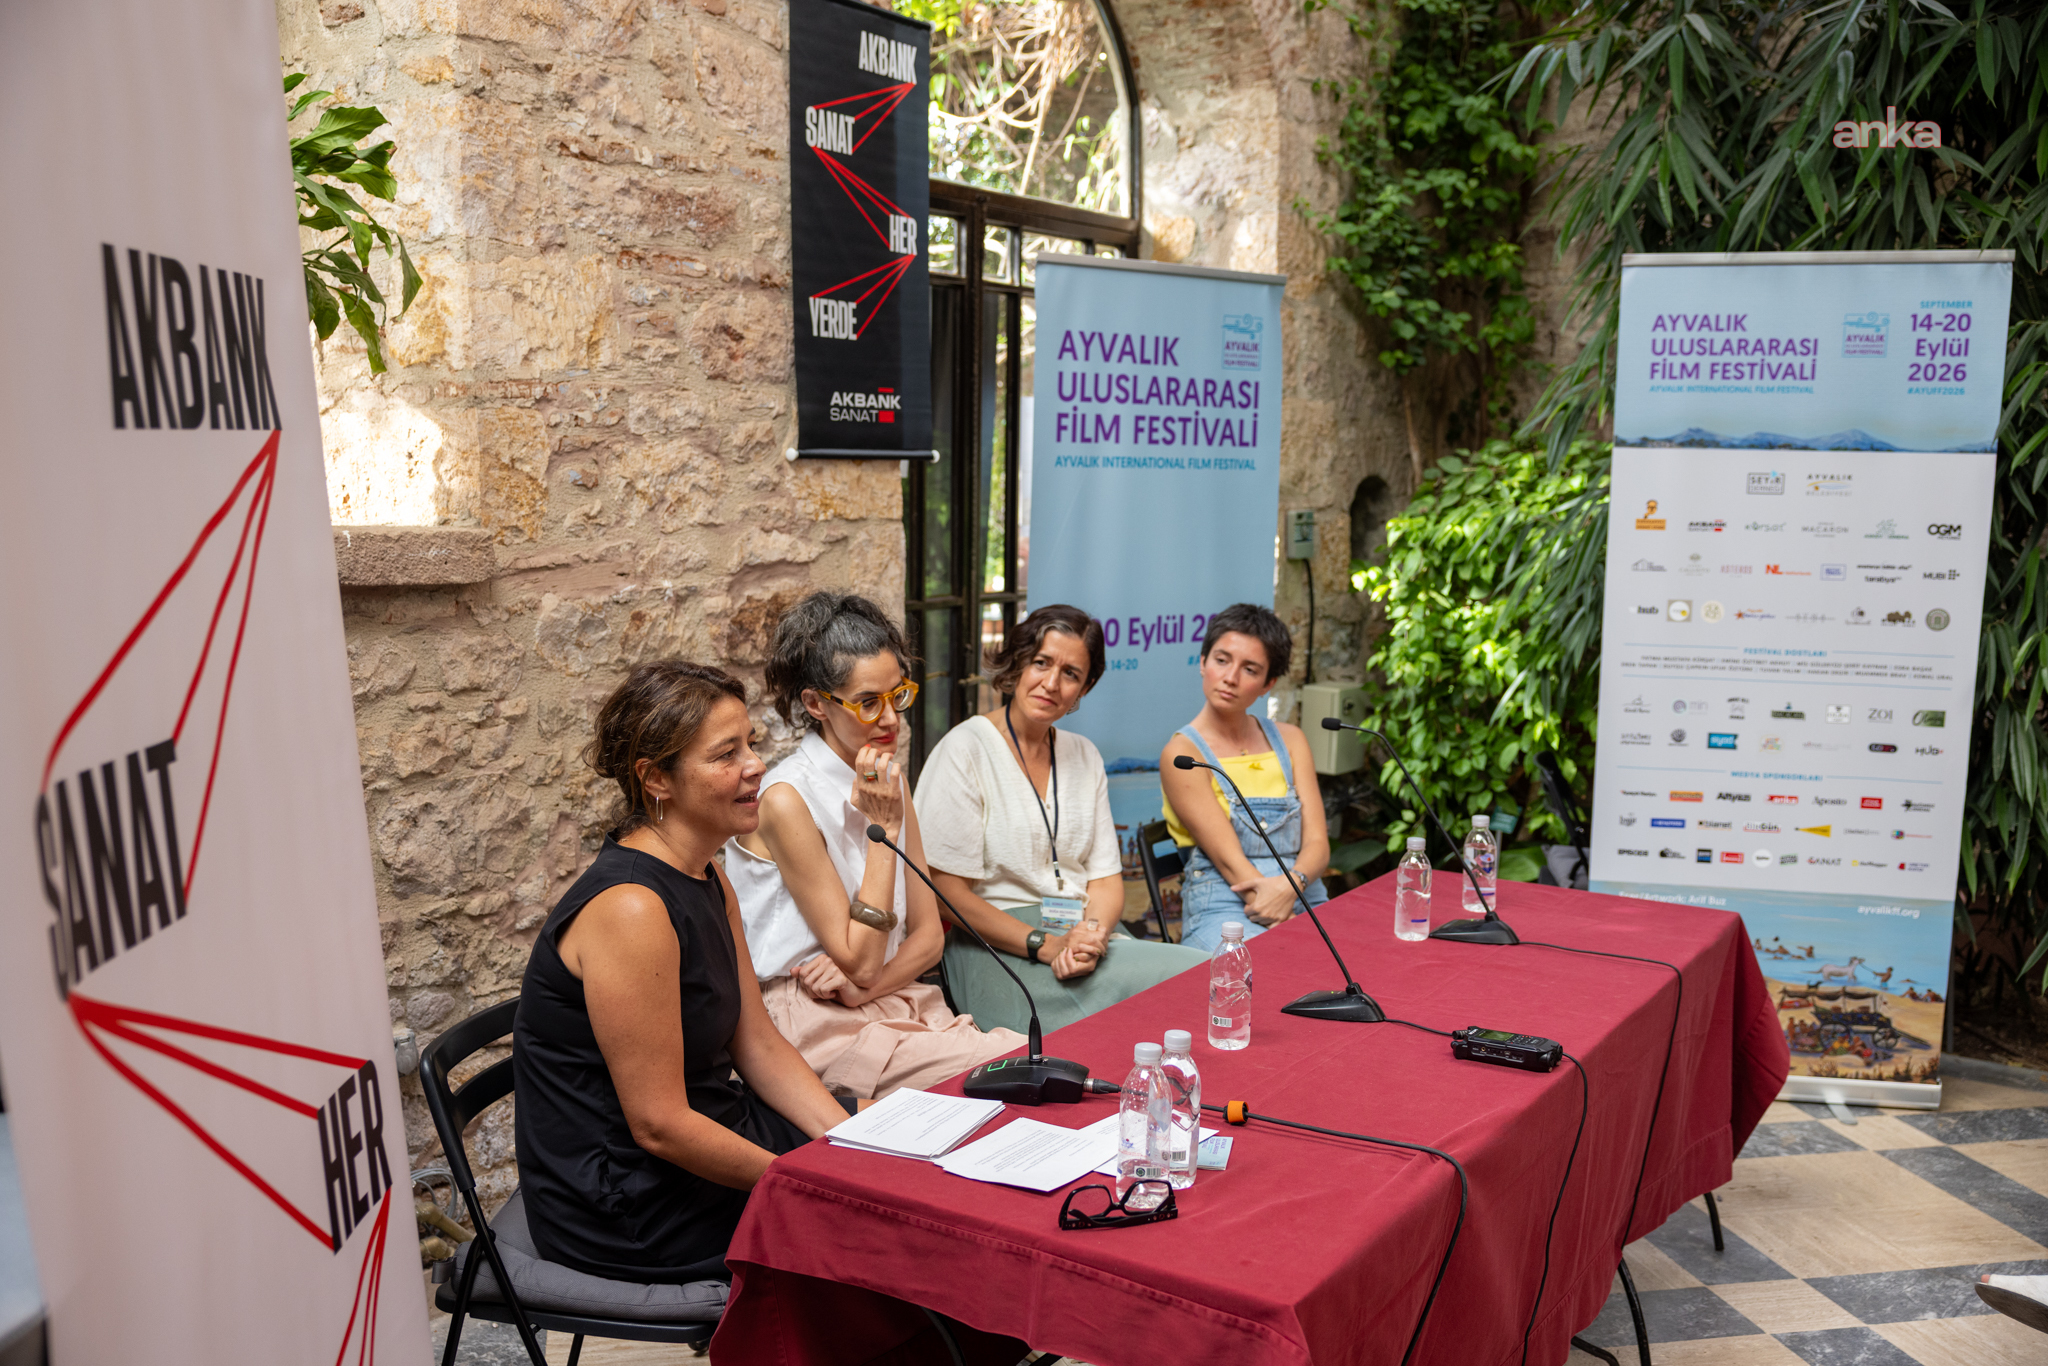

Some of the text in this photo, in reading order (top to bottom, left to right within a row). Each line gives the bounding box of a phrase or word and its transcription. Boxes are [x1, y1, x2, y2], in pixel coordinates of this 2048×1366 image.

[858, 30, 918, 85] AKBANK
[805, 106, 855, 155] SANAT
[889, 213, 918, 256] HER
[1920, 300, 1973, 309] SEPTEMBER
[809, 296, 857, 341] YERDE
[1651, 313, 1748, 333] AYVALIK
[1910, 312, 1972, 332] 14-20
[100, 241, 282, 430] AKBANK
[1651, 336, 1819, 357] ULUSLARARASI
[1057, 329, 1180, 367] AYVALIK
[1915, 337, 1970, 361] Eylül
[1649, 358, 1817, 381] FİLM FESTİVALİ
[1907, 362, 1967, 383] 2026
[830, 391, 902, 410] AKBANK
[1057, 371, 1260, 411] ULUSLARARASI
[829, 407, 879, 423] SANAT
[1055, 405, 1259, 448] FİLM FESTİVALİ
[1054, 455, 1256, 471] AYVALIK INTERNATIONAL FILM FESTIVAL
[1927, 523, 1962, 537] OGM
[1128, 614, 1185, 652] Eylül
[1110, 657, 1139, 671] 14-20
[35, 738, 188, 1003] SANAT
[317, 1059, 393, 1256] HER
